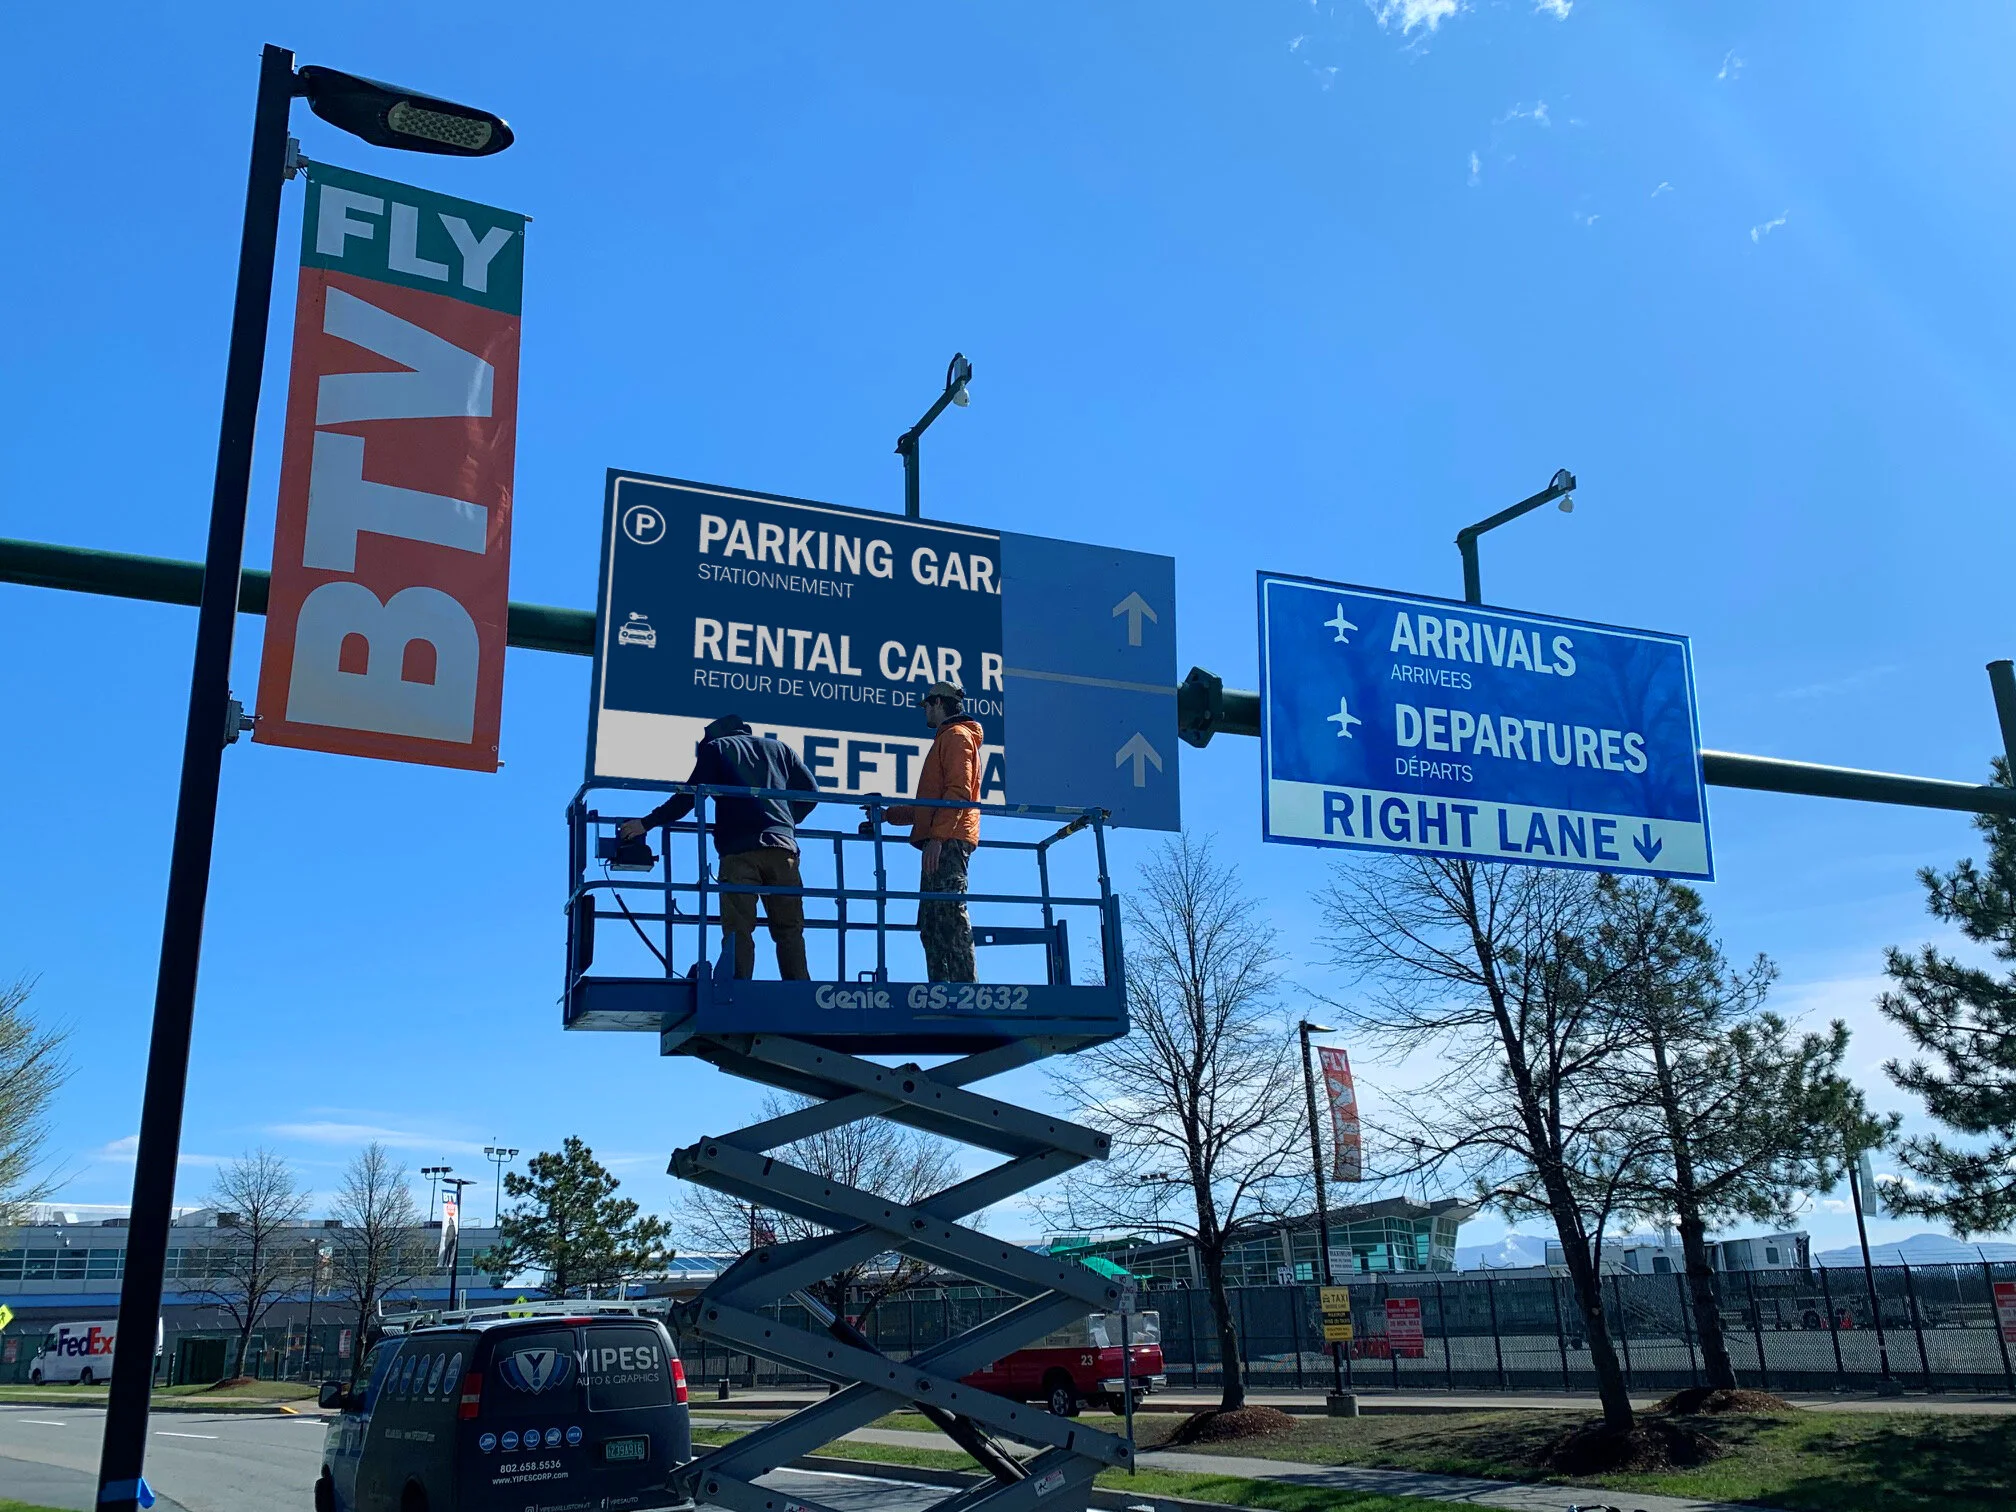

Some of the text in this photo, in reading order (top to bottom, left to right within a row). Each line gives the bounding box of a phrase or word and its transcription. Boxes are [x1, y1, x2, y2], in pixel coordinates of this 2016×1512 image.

[316, 184, 515, 293] FLY
[285, 286, 495, 744] BTV
[636, 513, 656, 536] P
[699, 514, 1001, 595] PARKING GAR
[698, 562, 854, 600] STATIONNEMENT
[694, 617, 862, 677] RENTAL
[879, 640, 964, 688] CAR
[1390, 611, 1577, 677] ARRIVALS
[694, 670, 772, 694] RETOUR
[779, 679, 804, 698] DE
[808, 681, 887, 706] VOITURE
[892, 690, 917, 708] DE
[1391, 663, 1472, 690] ARRIVEES
[1396, 703, 1648, 774] DEPARTURES
[764, 731, 920, 795] EFT
[1396, 755, 1473, 783] DÉPARTS
[1323, 790, 1620, 862] RIGHT LANE
[815, 984, 1029, 1011] Genie GS-2632
[1321, 1051, 1347, 1072] FLY
[1331, 1294, 1348, 1303] TAXI
[57, 1327, 114, 1356] FedEx
[573, 1346, 660, 1374] YIPES!
[1081, 1355, 1094, 1366] 23
[575, 1373, 660, 1388] AUTO & GRAPHICS
[492, 1471, 569, 1485] www.YIPESCORP.com
[500, 1460, 561, 1473] 802.658.5536
